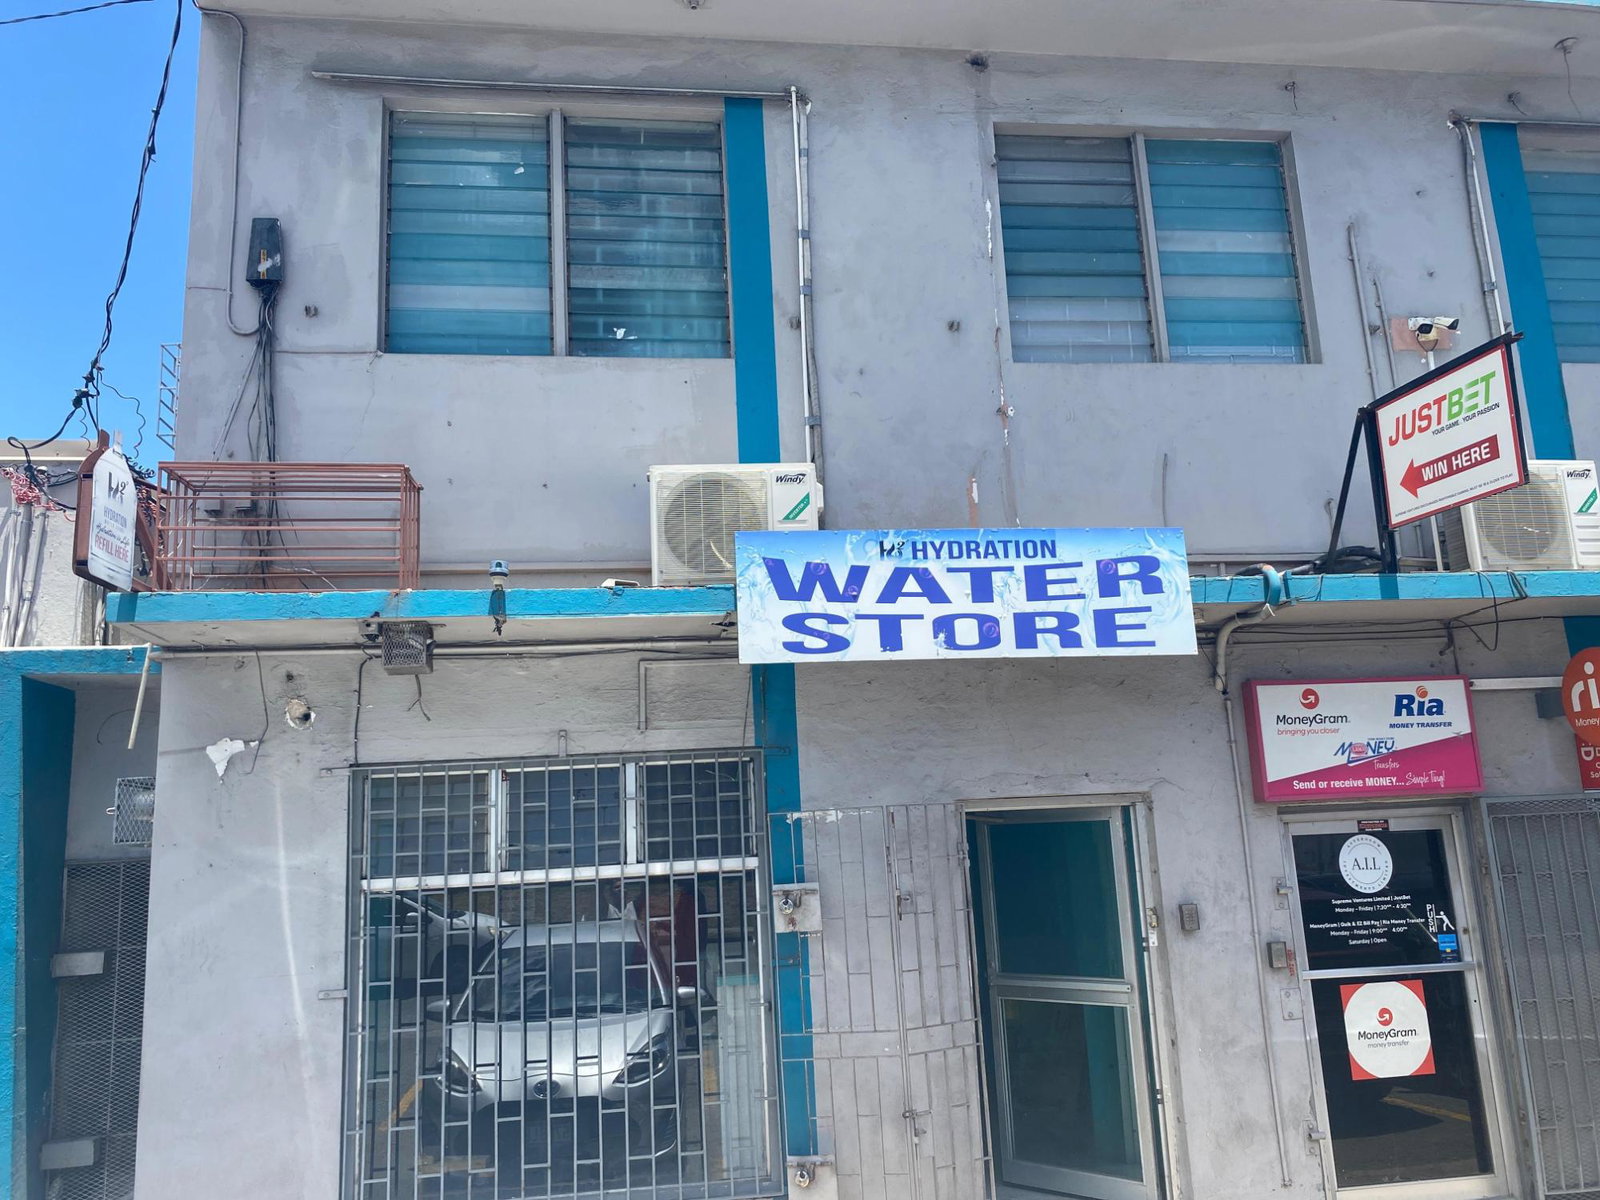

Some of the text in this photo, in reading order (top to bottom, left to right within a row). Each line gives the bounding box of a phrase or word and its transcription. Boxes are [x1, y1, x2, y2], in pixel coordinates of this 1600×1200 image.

[1388, 370, 1496, 446] JUSTBET
[1432, 426, 1446, 436] YOUR
[1462, 412, 1477, 423] YOUR
[1477, 402, 1500, 417] PASSION
[1421, 442, 1491, 482] WIN HERE
[1566, 468, 1591, 479] Windy
[776, 473, 806, 484] Windy
[911, 539, 1057, 560] HYDRATION
[762, 554, 1165, 604] WATER
[781, 606, 1157, 655] STORE
[1394, 686, 1444, 716] Ria
[1276, 713, 1348, 727] MoneyGram
[1277, 728, 1306, 736] bringing
[1293, 780, 1316, 790] Send
[1330, 778, 1363, 788] receive
[1365, 777, 1404, 787] MONEY...
[1426, 904, 1436, 932] PUSH
[1358, 1028, 1417, 1041] MoneyGram
